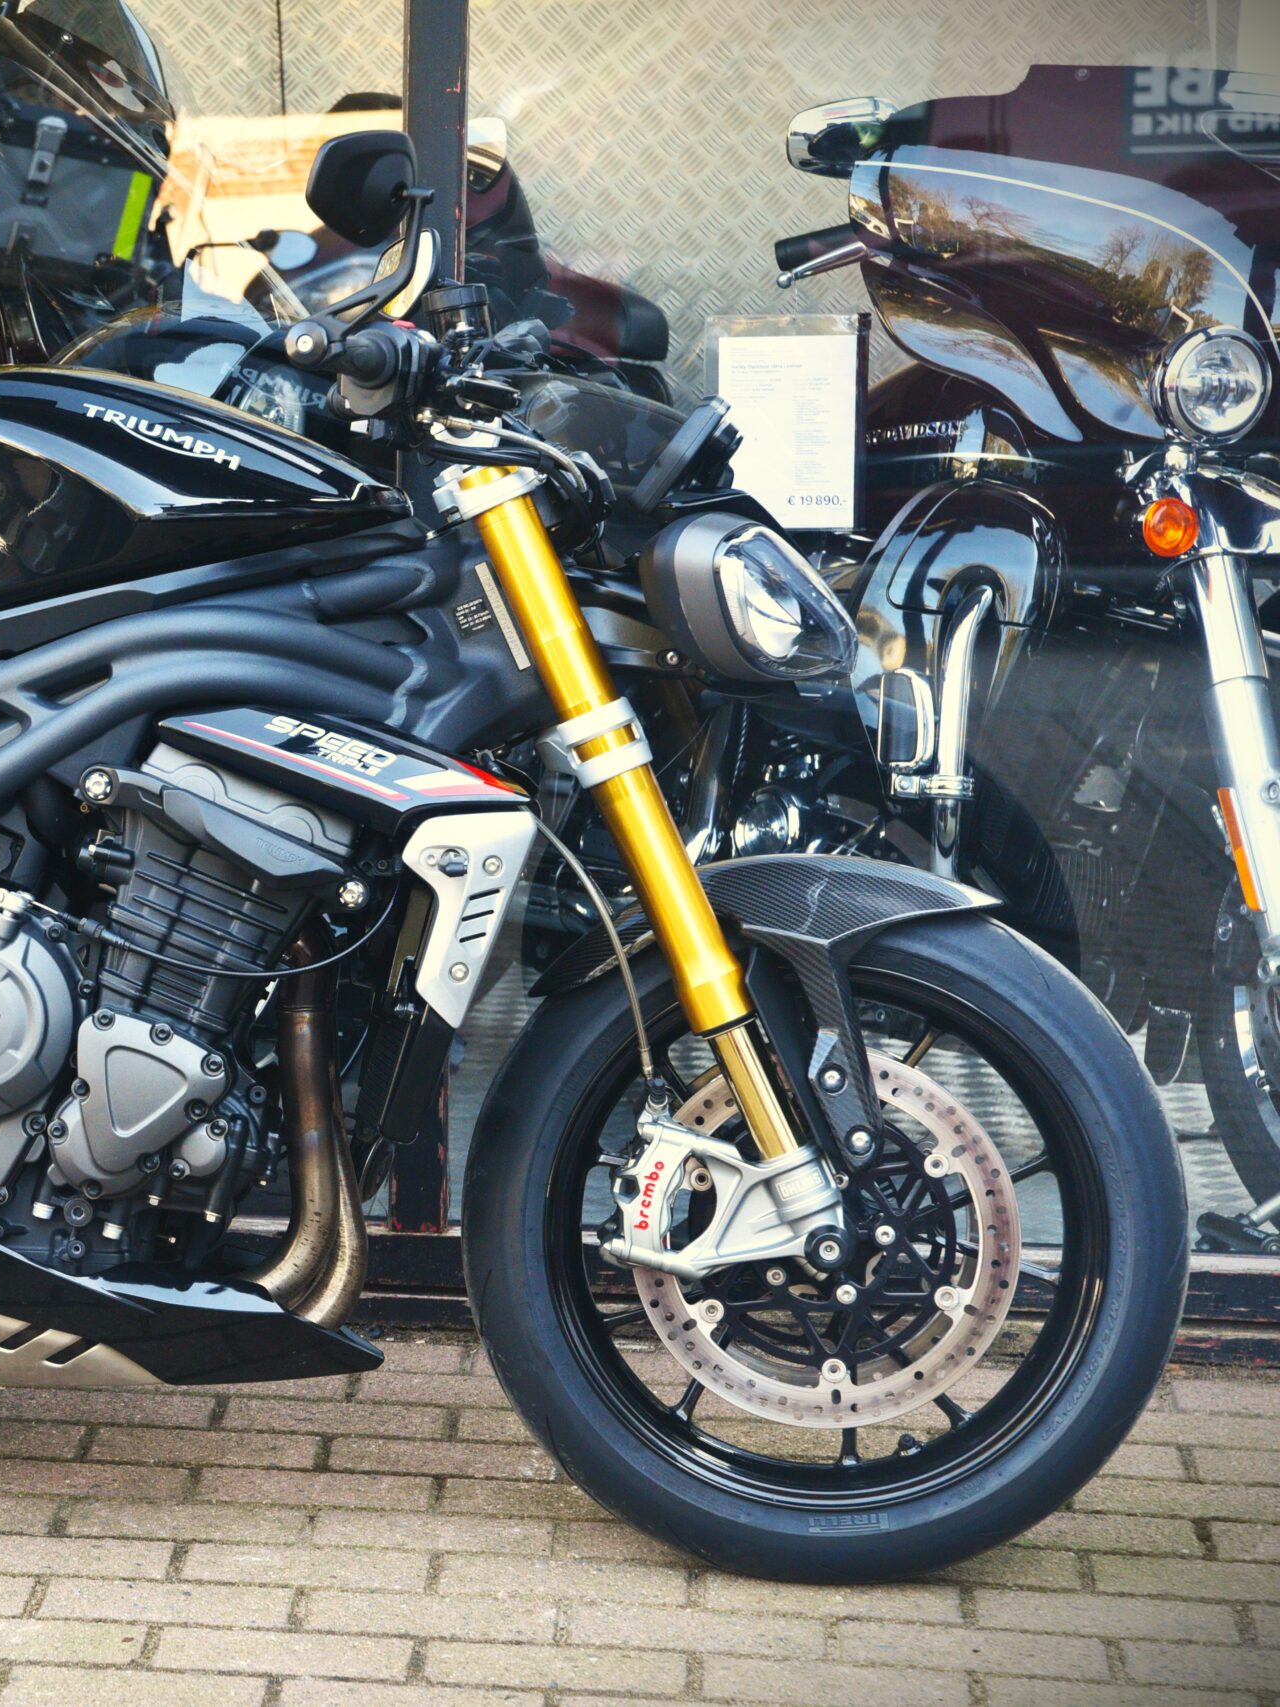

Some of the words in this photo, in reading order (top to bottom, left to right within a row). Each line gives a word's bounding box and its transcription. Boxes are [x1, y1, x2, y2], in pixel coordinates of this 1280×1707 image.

[83, 403, 241, 471] TRIUMPH
[264, 715, 397, 768] SPEED
[317, 747, 382, 777] TRIPLE
[633, 1161, 665, 1230] brembo
[808, 1509, 890, 1535] PIRELLI
